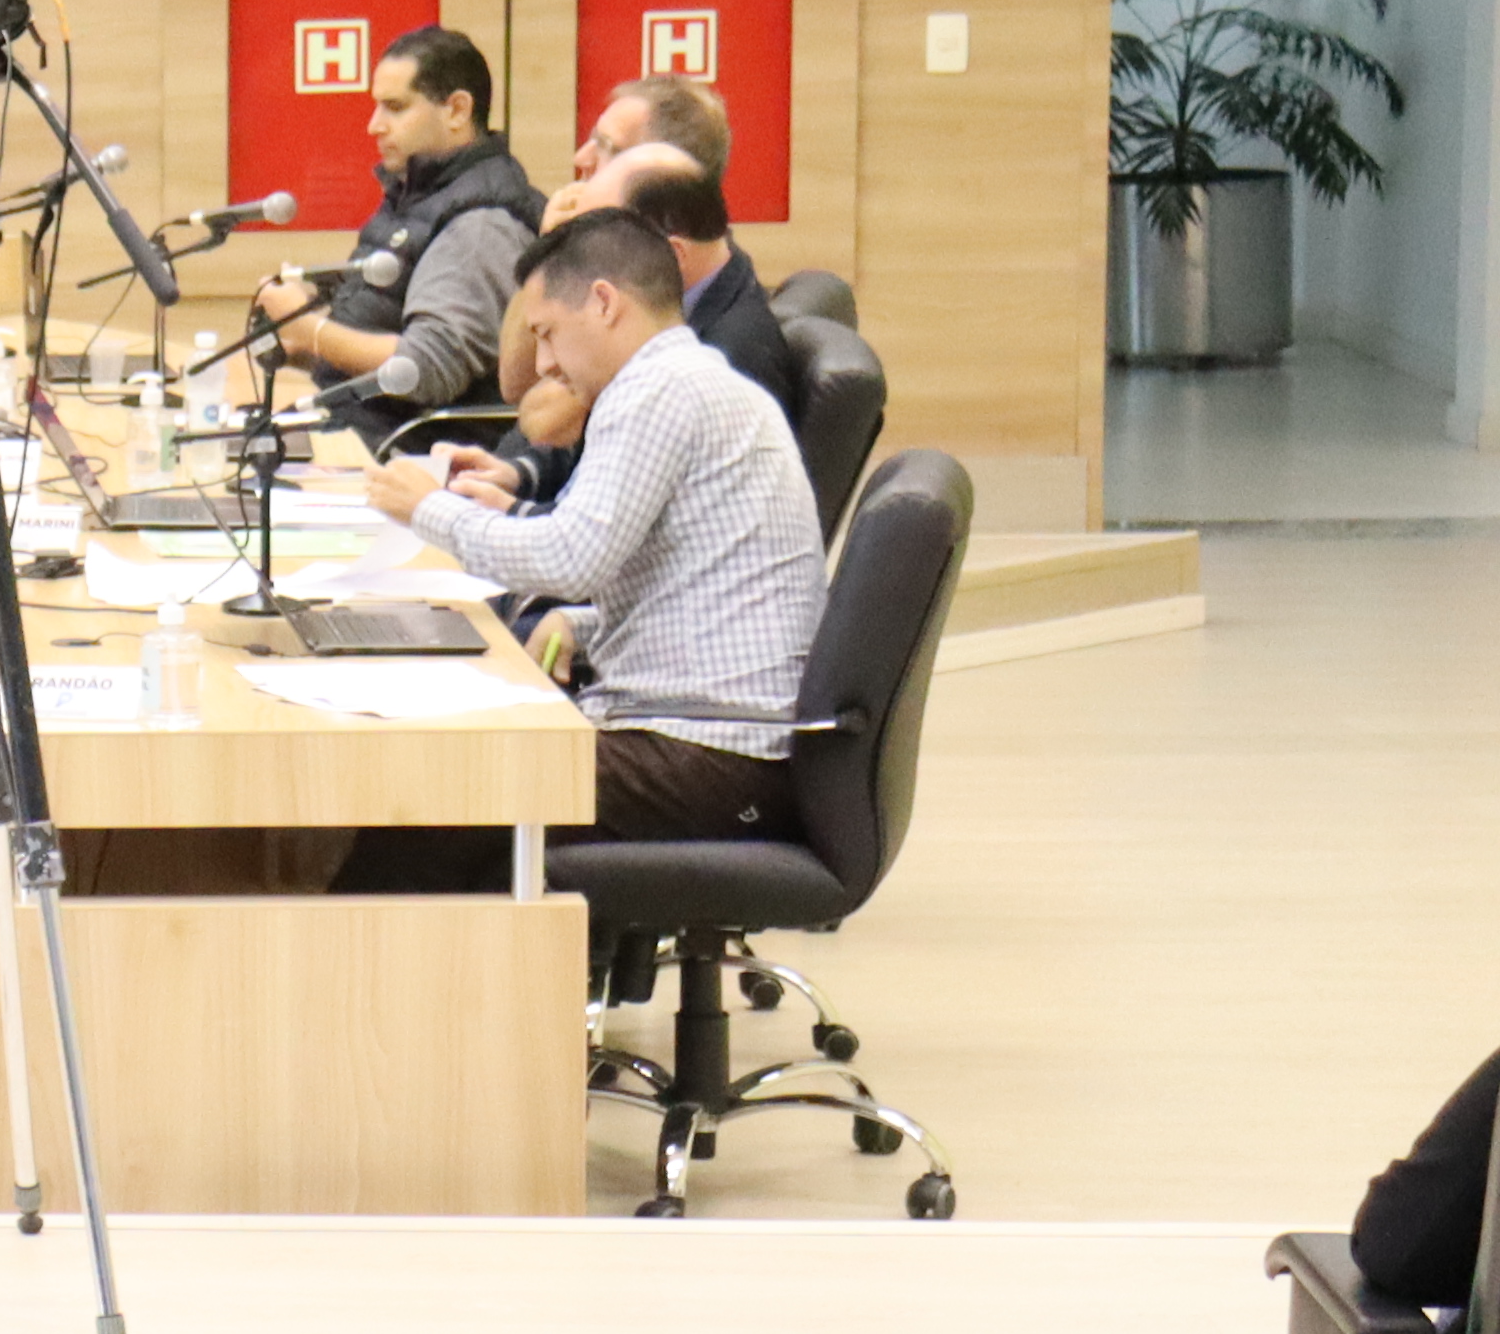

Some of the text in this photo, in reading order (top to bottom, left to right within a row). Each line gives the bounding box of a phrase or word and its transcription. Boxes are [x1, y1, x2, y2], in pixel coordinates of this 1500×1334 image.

[307, 32, 357, 82] H
[653, 23, 704, 73] H
[17, 517, 75, 530] MARINI
[30, 674, 113, 690] RANDÃO
